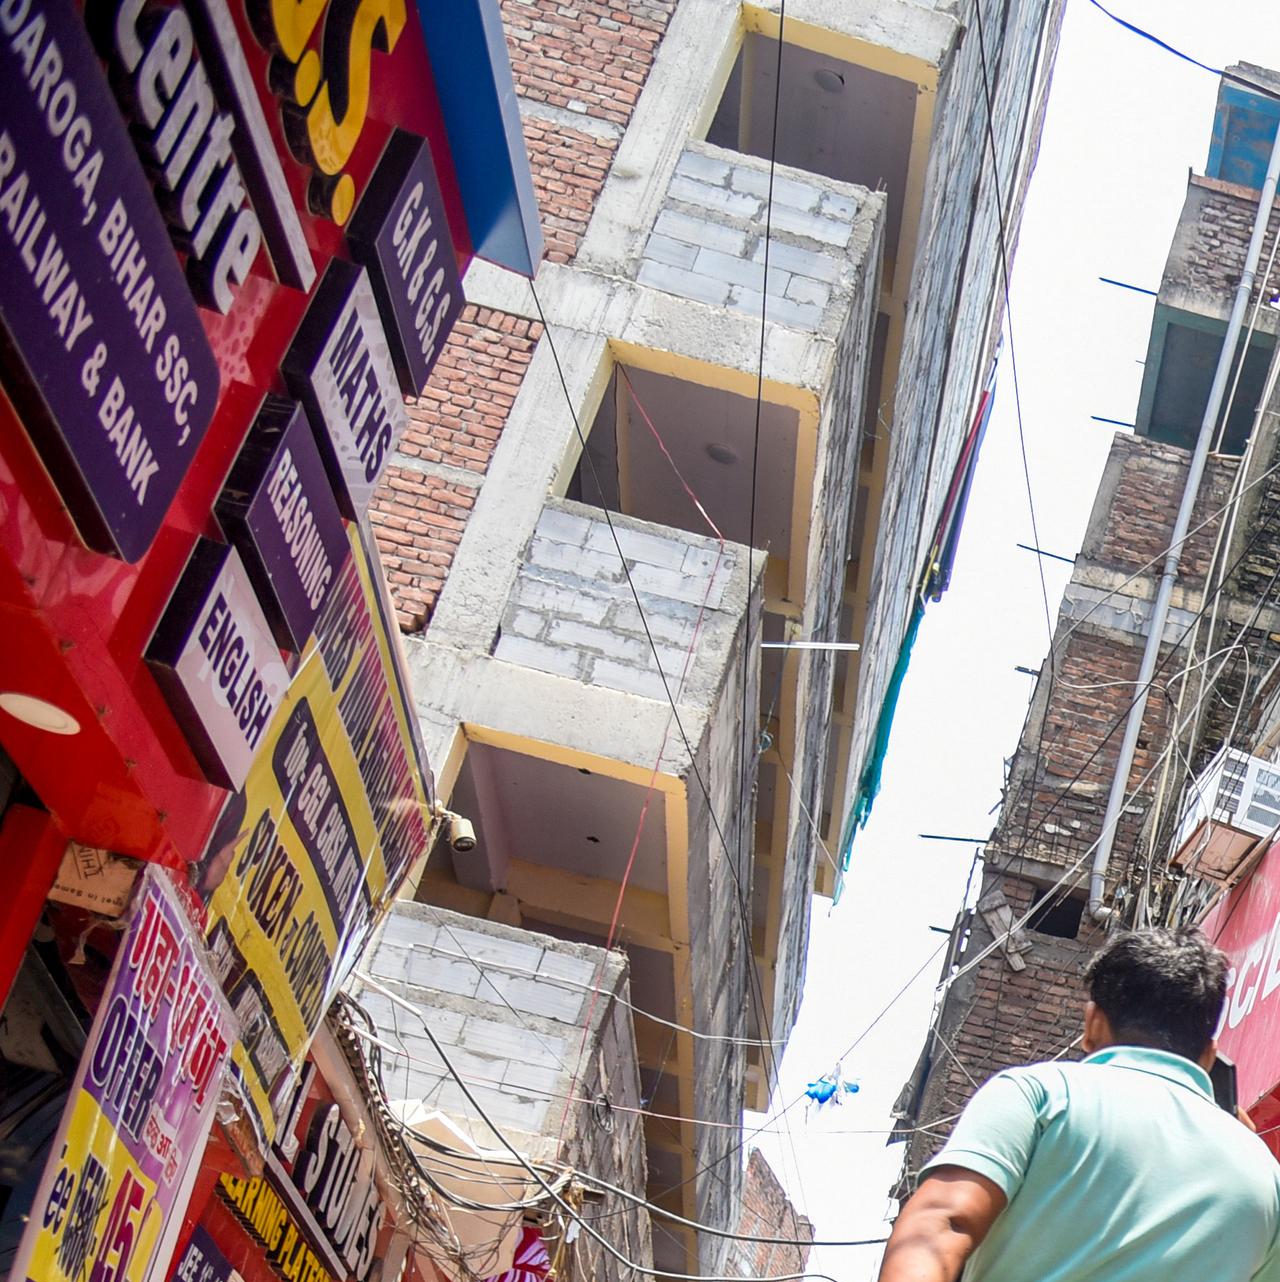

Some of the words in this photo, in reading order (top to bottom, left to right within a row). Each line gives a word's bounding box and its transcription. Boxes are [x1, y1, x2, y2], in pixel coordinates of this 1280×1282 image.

[99, 198, 166, 354] BIHAR
[156, 334, 198, 447] SSC,
[328, 303, 393, 482] MATHS
[82, 343, 107, 397] &
[98, 375, 160, 506] BANK
[266, 447, 331, 611] REASONING
[198, 592, 272, 752] ENGLISH
[92, 992, 165, 1144] OFFER
